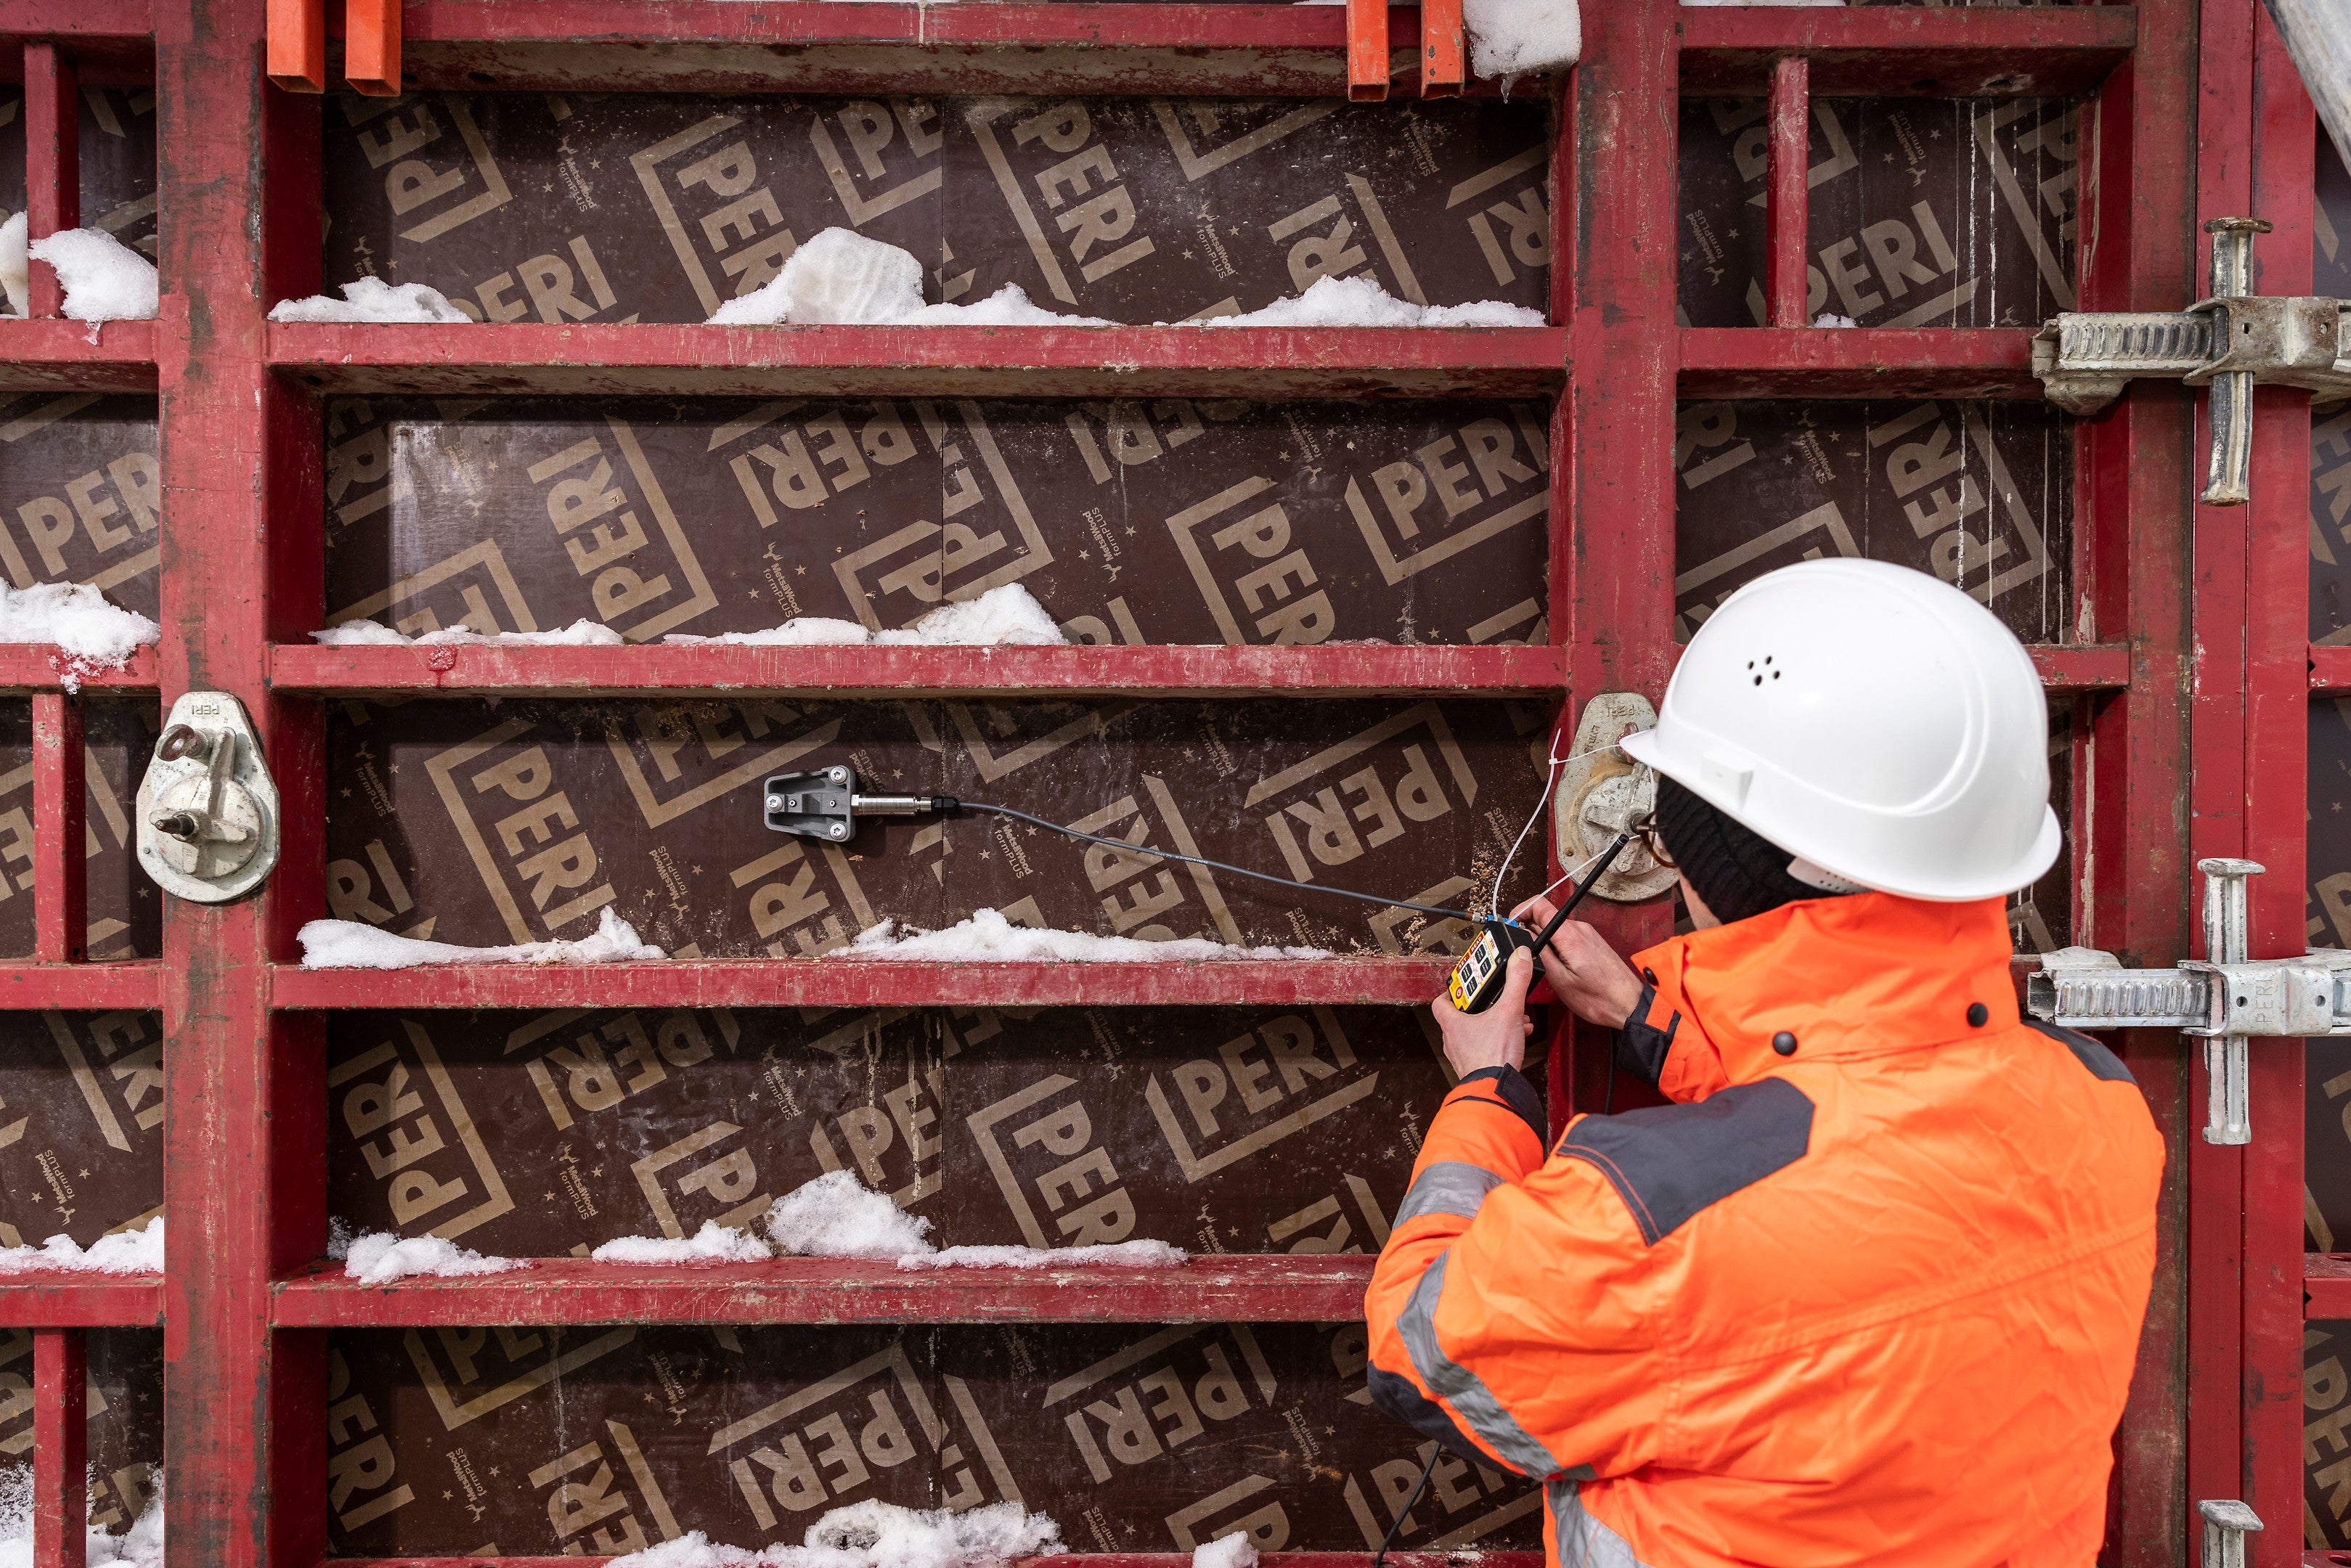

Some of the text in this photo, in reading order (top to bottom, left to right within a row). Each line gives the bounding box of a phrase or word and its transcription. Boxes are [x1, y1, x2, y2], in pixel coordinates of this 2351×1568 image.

[340, 94, 465, 216] PE
[836, 97, 942, 181] PE
[1896, 109, 1927, 160] formPLUS
[677, 140, 799, 297] PER
[1011, 98, 1156, 285] PERI
[1467, 186, 1552, 288] RI
[1694, 208, 1725, 259] formPLUS
[448, 234, 618, 324] ERI
[1195, 228, 1226, 279] formPLUS
[1266, 194, 1378, 293] RI
[1808, 200, 1959, 327] ERI
[728, 400, 918, 529] PERI
[1064, 401, 1247, 484] ERI
[1372, 404, 1549, 540] PERI
[1676, 401, 1757, 490] RI
[16, 452, 160, 577] PER
[526, 436, 672, 623] PERI
[1091, 506, 1122, 557] formPLUS
[1868, 401, 2010, 582] PERI
[762, 567, 793, 618] formPLUS
[1211, 502, 1336, 645] PER
[354, 766, 386, 817] formPLUS
[857, 748, 887, 795] ormPLUS
[1266, 743, 1451, 883] PERI
[327, 838, 415, 925] RI
[471, 744, 617, 931] PERI
[657, 844, 688, 895] formPLUS
[993, 828, 1024, 879] formPLUS
[1066, 795, 1204, 939] ERI
[729, 840, 850, 958] ERI
[1294, 906, 1322, 952] ormPLUS
[1470, 935, 1481, 952] READ
[1458, 956, 1467, 970] SET
[2255, 978, 2274, 1024] PERI
[525, 1008, 714, 1132] PERI
[762, 1070, 793, 1121] formPLUS
[1172, 1008, 1358, 1138] PERI
[327, 1040, 469, 1227] PERI
[837, 1067, 942, 1183] PE
[1398, 1127, 1420, 1159] formP
[44, 1148, 75, 1199] formPLUS
[558, 1169, 589, 1220] formPLUS
[1011, 1100, 1136, 1247] PER
[1195, 1229, 1213, 1255] form
[327, 1349, 415, 1533] ERI
[728, 1390, 918, 1531] PERI
[1064, 1343, 1252, 1485] PERI
[1290, 1405, 1321, 1456] formPLUS
[455, 1446, 486, 1497] formPLUS
[528, 1440, 649, 1556] ERI
[1371, 1437, 1506, 1537] PE
[1091, 1505, 1121, 1553] ormPLUS
